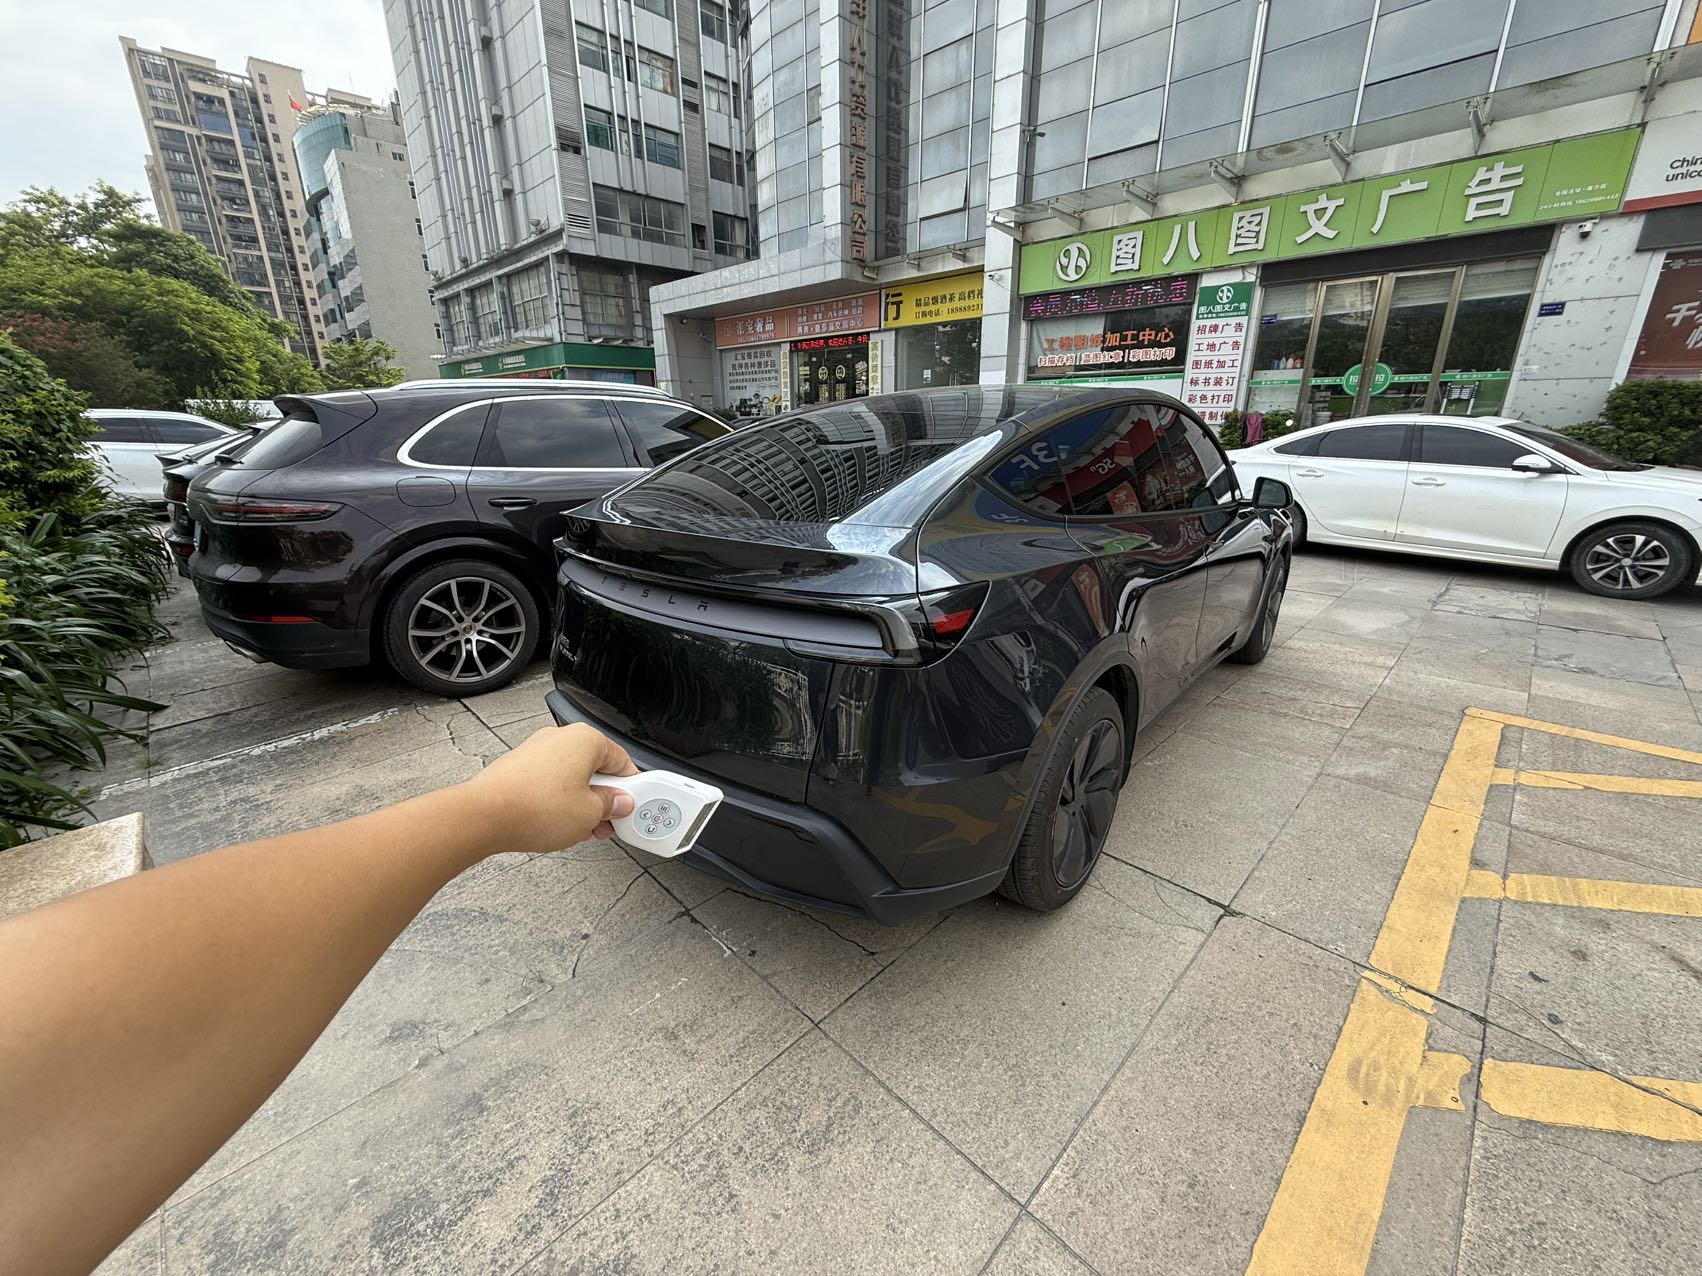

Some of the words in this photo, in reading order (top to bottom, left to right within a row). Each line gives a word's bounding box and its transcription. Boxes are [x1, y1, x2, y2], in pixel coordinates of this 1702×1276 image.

[1110, 161, 1524, 274] 图八图文广告
[884, 292, 903, 322] 行
[1198, 302, 1248, 314] 图八图文广告
[1196, 321, 1244, 335] 招牌广告
[1043, 325, 1175, 351] 工程图纸加工中心
[1193, 340, 1242, 352] 工地广告
[1037, 353, 1076, 368] 扫描存档
[1080, 350, 1123, 365] 蓝图红章
[1128, 346, 1176, 361] 彩图打印
[1191, 358, 1239, 370] 图纸加工
[1189, 376, 1237, 387] 标书装订
[1187, 393, 1234, 405] 彩色打印
[601, 576, 709, 612] TESLA
